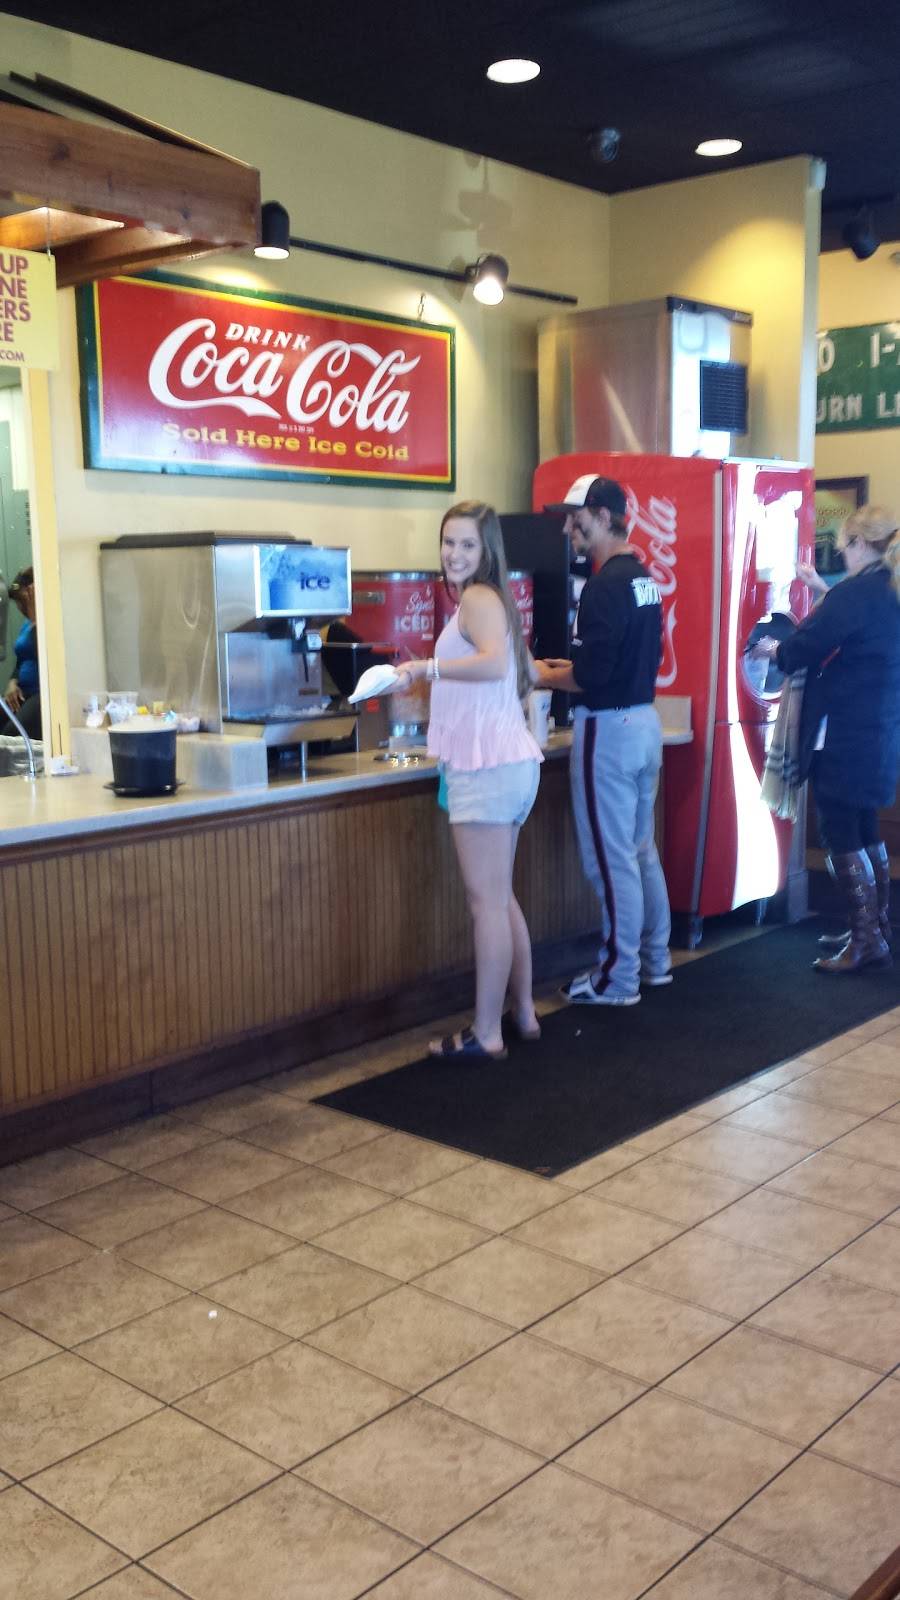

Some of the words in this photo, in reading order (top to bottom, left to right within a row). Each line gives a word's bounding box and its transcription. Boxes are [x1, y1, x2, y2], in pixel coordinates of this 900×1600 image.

[224, 321, 311, 351] DRINK
[148, 317, 284, 420] Coca
[286, 339, 422, 435] Cola
[161, 421, 228, 445] Sold
[235, 428, 301, 451] Here
[308, 435, 348, 456] Ice
[354, 440, 410, 462] Cold
[300, 572, 331, 591] ice
